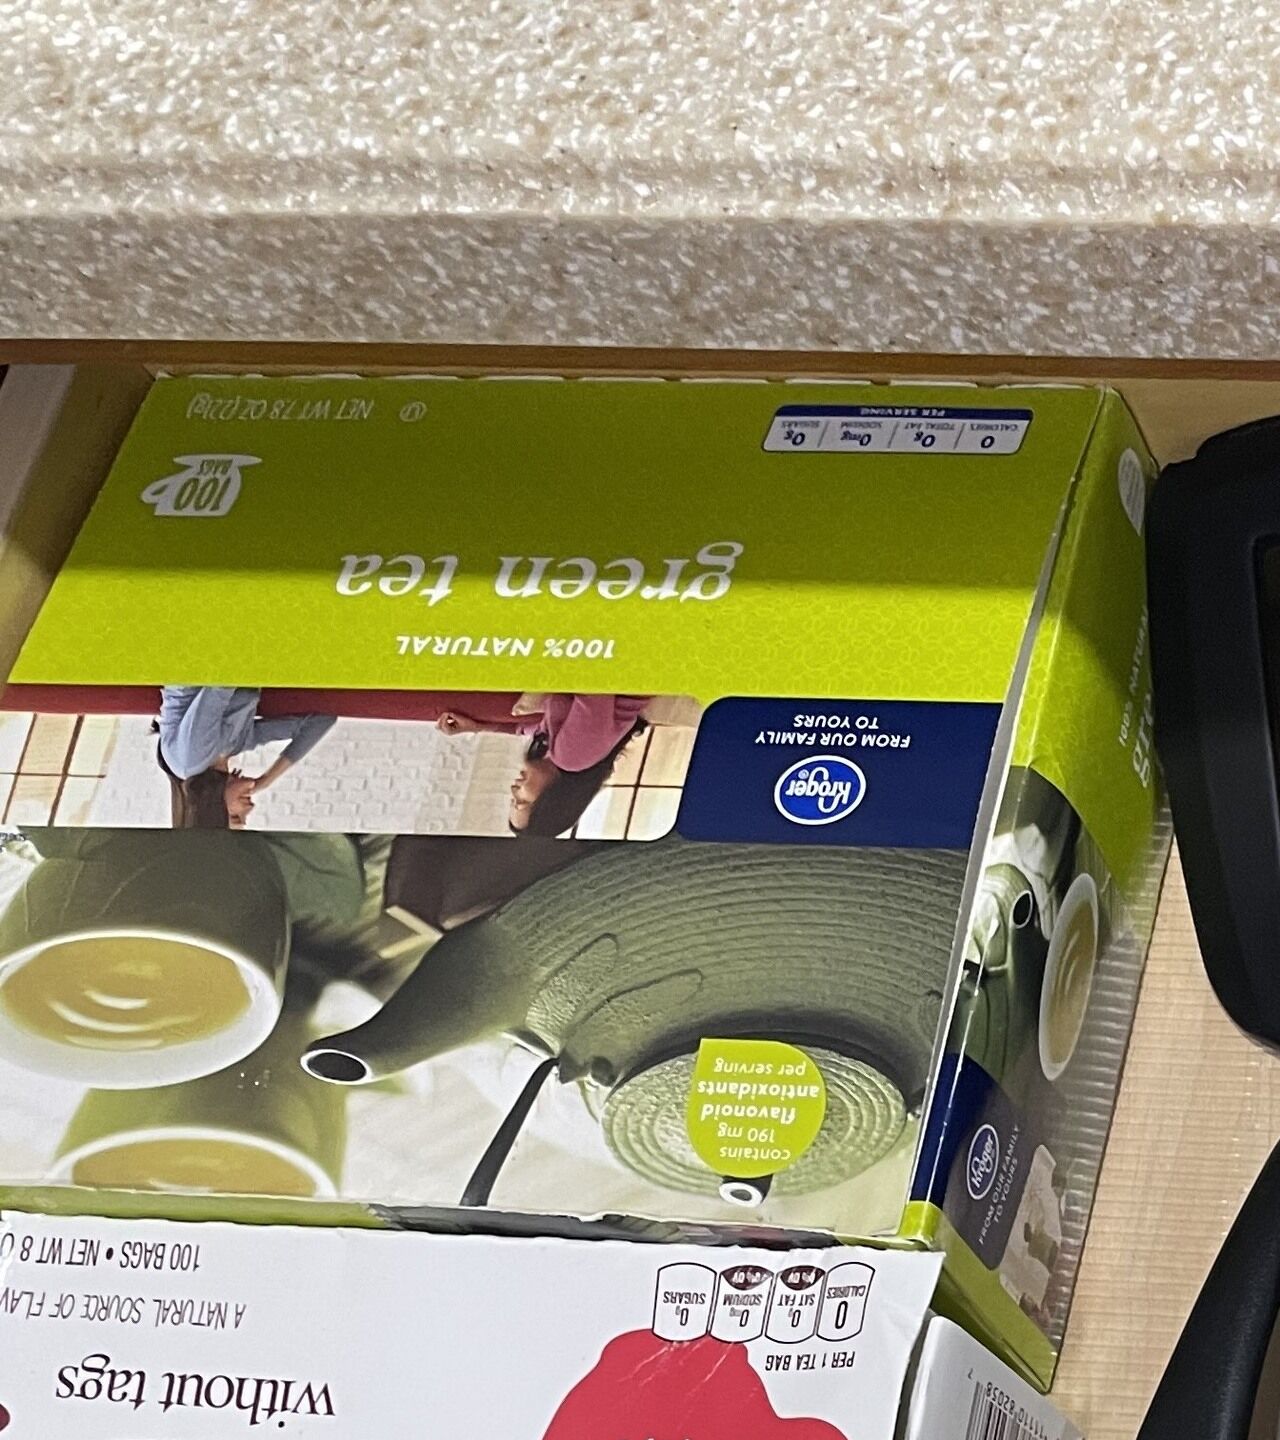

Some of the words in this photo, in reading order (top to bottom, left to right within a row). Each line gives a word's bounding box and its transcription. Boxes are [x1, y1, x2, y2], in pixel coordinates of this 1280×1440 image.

[172, 476, 231, 512] 100
[334, 552, 460, 607] tea
[493, 540, 745, 603] green
[395, 634, 535, 658] NATURAL
[543, 637, 616, 660] 100%
[792, 714, 851, 729] YOURS
[854, 715, 880, 730] TO
[754, 731, 817, 746] FAMILY
[819, 732, 857, 747] OUR
[860, 733, 911, 748] FROM
[784, 766, 852, 814] Kroger
[713, 1057, 774, 1077] serving
[777, 1060, 807, 1077] per
[697, 1080, 820, 1101] antioxidants
[700, 1103, 797, 1125] flavonoid
[717, 1121, 743, 1138] mg
[747, 1127, 776, 1144] 190
[719, 1146, 791, 1161] contains
[0, 1232, 15, 1260] O
[19, 1235, 34, 1263] 8
[35, 1236, 63, 1265] WT
[64, 1238, 101, 1267] NET
[120, 1240, 166, 1271] BAGS
[169, 1243, 201, 1272] 100
[0, 1286, 46, 1320] FLAV
[48, 1292, 76, 1320] OF
[80, 1294, 146, 1325] SOURCE
[662, 1291, 707, 1305] SUGARS
[152, 1299, 229, 1331] NATURAL
[233, 1303, 247, 1330] A
[834, 1301, 849, 1330] 0
[764, 1354, 792, 1372] BAG
[796, 1354, 817, 1371] TEA
[821, 1352, 828, 1369] 1
[831, 1351, 856, 1369] PER
[55, 1353, 150, 1411] tags
[157, 1371, 336, 1429] without
